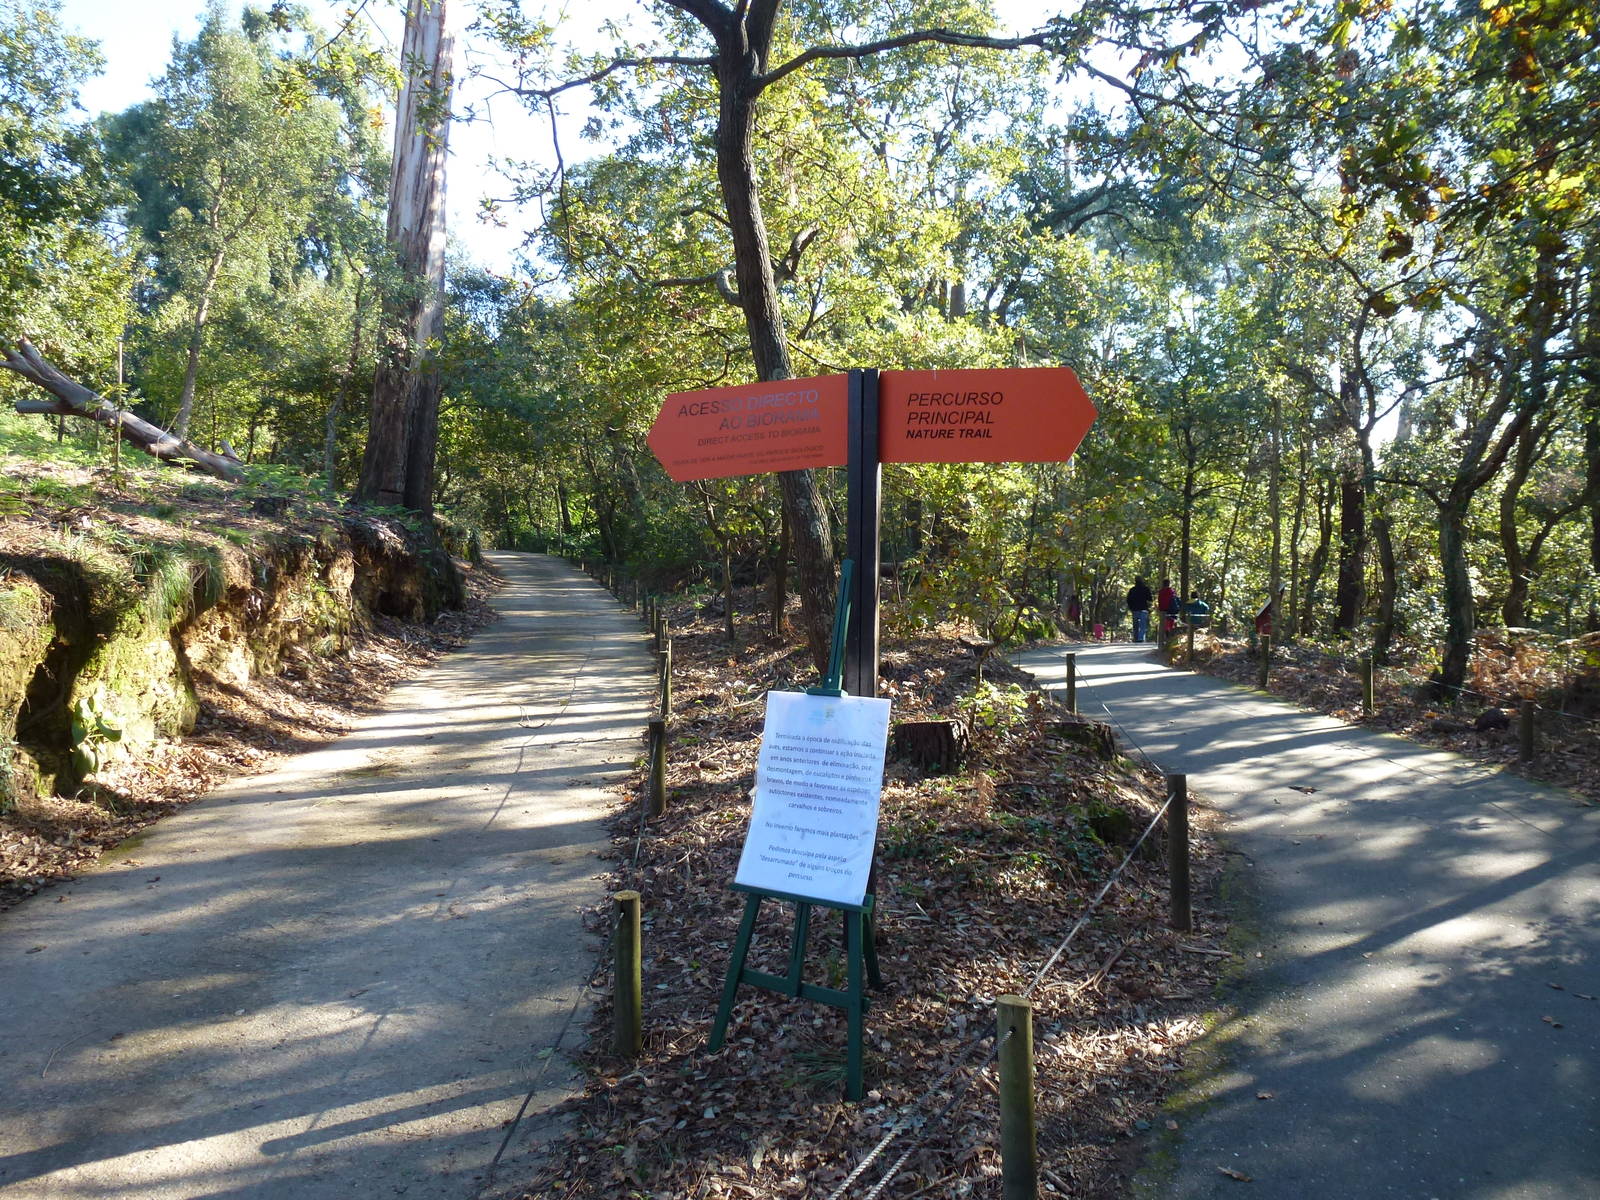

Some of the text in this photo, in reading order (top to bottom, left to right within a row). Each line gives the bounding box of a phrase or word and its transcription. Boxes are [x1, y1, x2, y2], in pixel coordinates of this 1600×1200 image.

[678, 390, 819, 417] ACESSO DIRECTO
[908, 392, 1004, 407] PERCURSO
[719, 408, 820, 430] AO BIORAMA
[907, 411, 995, 424] PRINCIPAL
[698, 435, 729, 446] DIRECT
[731, 432, 765, 442] ACCESS
[768, 430, 780, 439] TO
[906, 429, 992, 439] NATURE TRAIL
[807, 735, 822, 744] época
[788, 803, 812, 811] carvalhos
